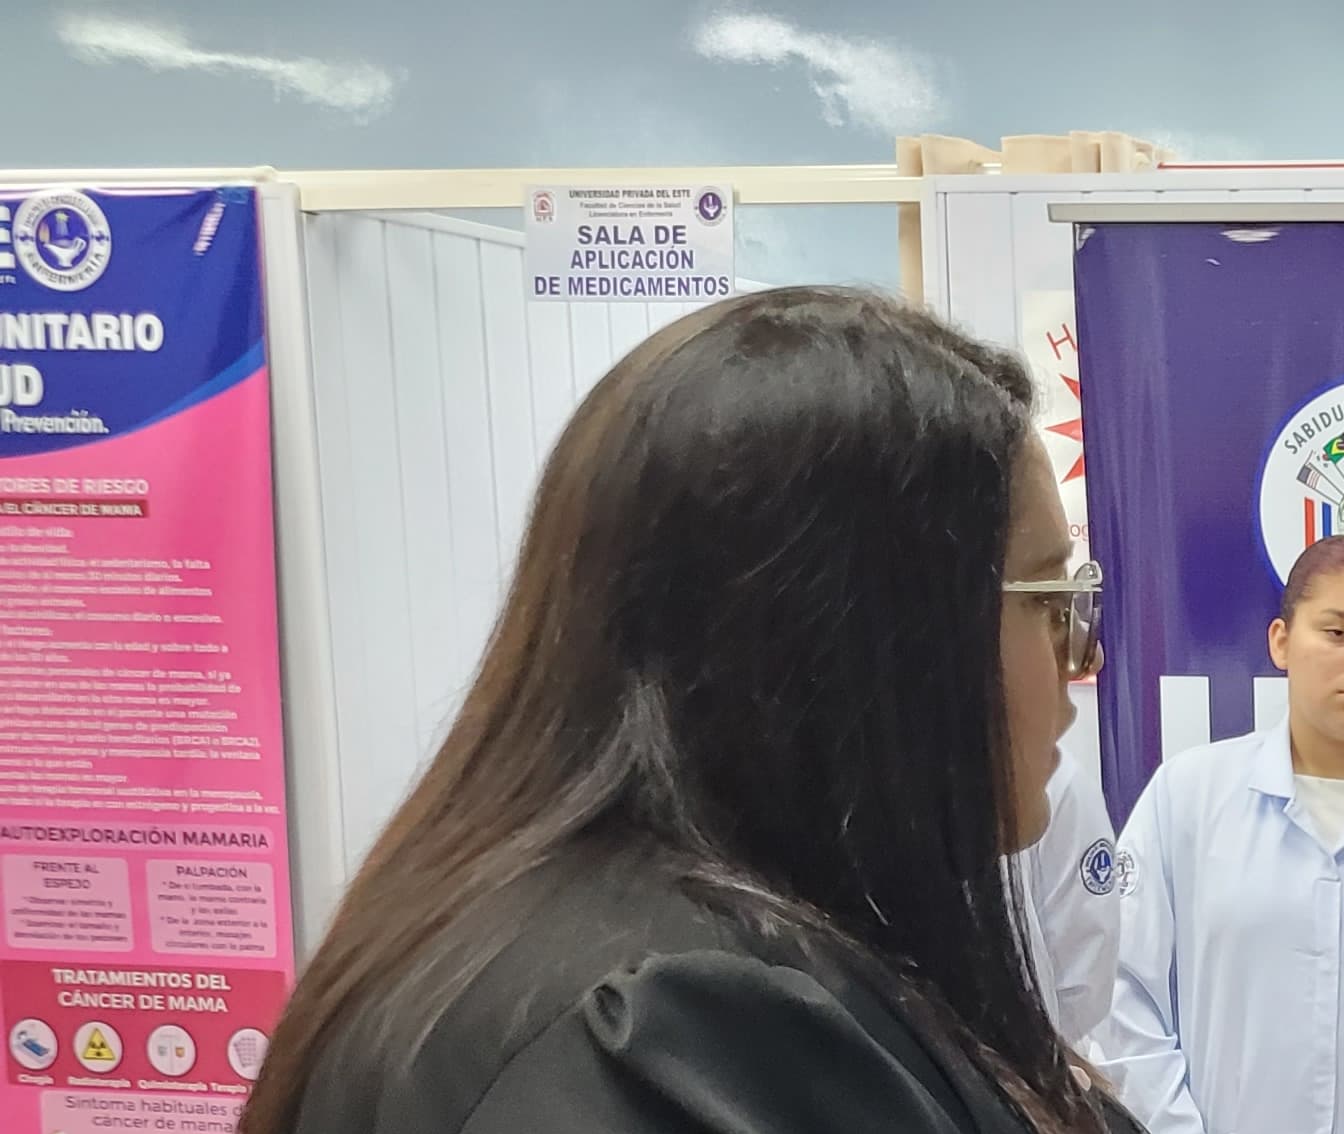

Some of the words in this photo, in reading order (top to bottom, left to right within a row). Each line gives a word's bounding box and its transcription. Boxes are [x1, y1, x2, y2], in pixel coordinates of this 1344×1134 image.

[622, 189, 654, 199] PRIVADA
[656, 189, 669, 198] DEL
[672, 189, 691, 198] ESTE
[577, 225, 645, 245] SALA
[654, 225, 687, 245] DE
[570, 245, 694, 269] APLICACIÓN
[534, 276, 561, 295] DE
[568, 276, 729, 296] MEDICAMENTOS
[1, 825, 176, 847] AUTOEXPLORACIÓN
[182, 830, 269, 849] MAMARIA
[176, 865, 248, 879] PALPACIÓN
[52, 967, 192, 989] TRATAMIENTOS
[196, 973, 231, 990] DEL
[58, 989, 134, 1009] CÁNCER
[139, 994, 165, 1010] DE
[168, 995, 228, 1013] MAMA
[141, 1099, 228, 1117] habituales
[155, 1115, 176, 1130] de
[181, 1118, 234, 1134] mama
